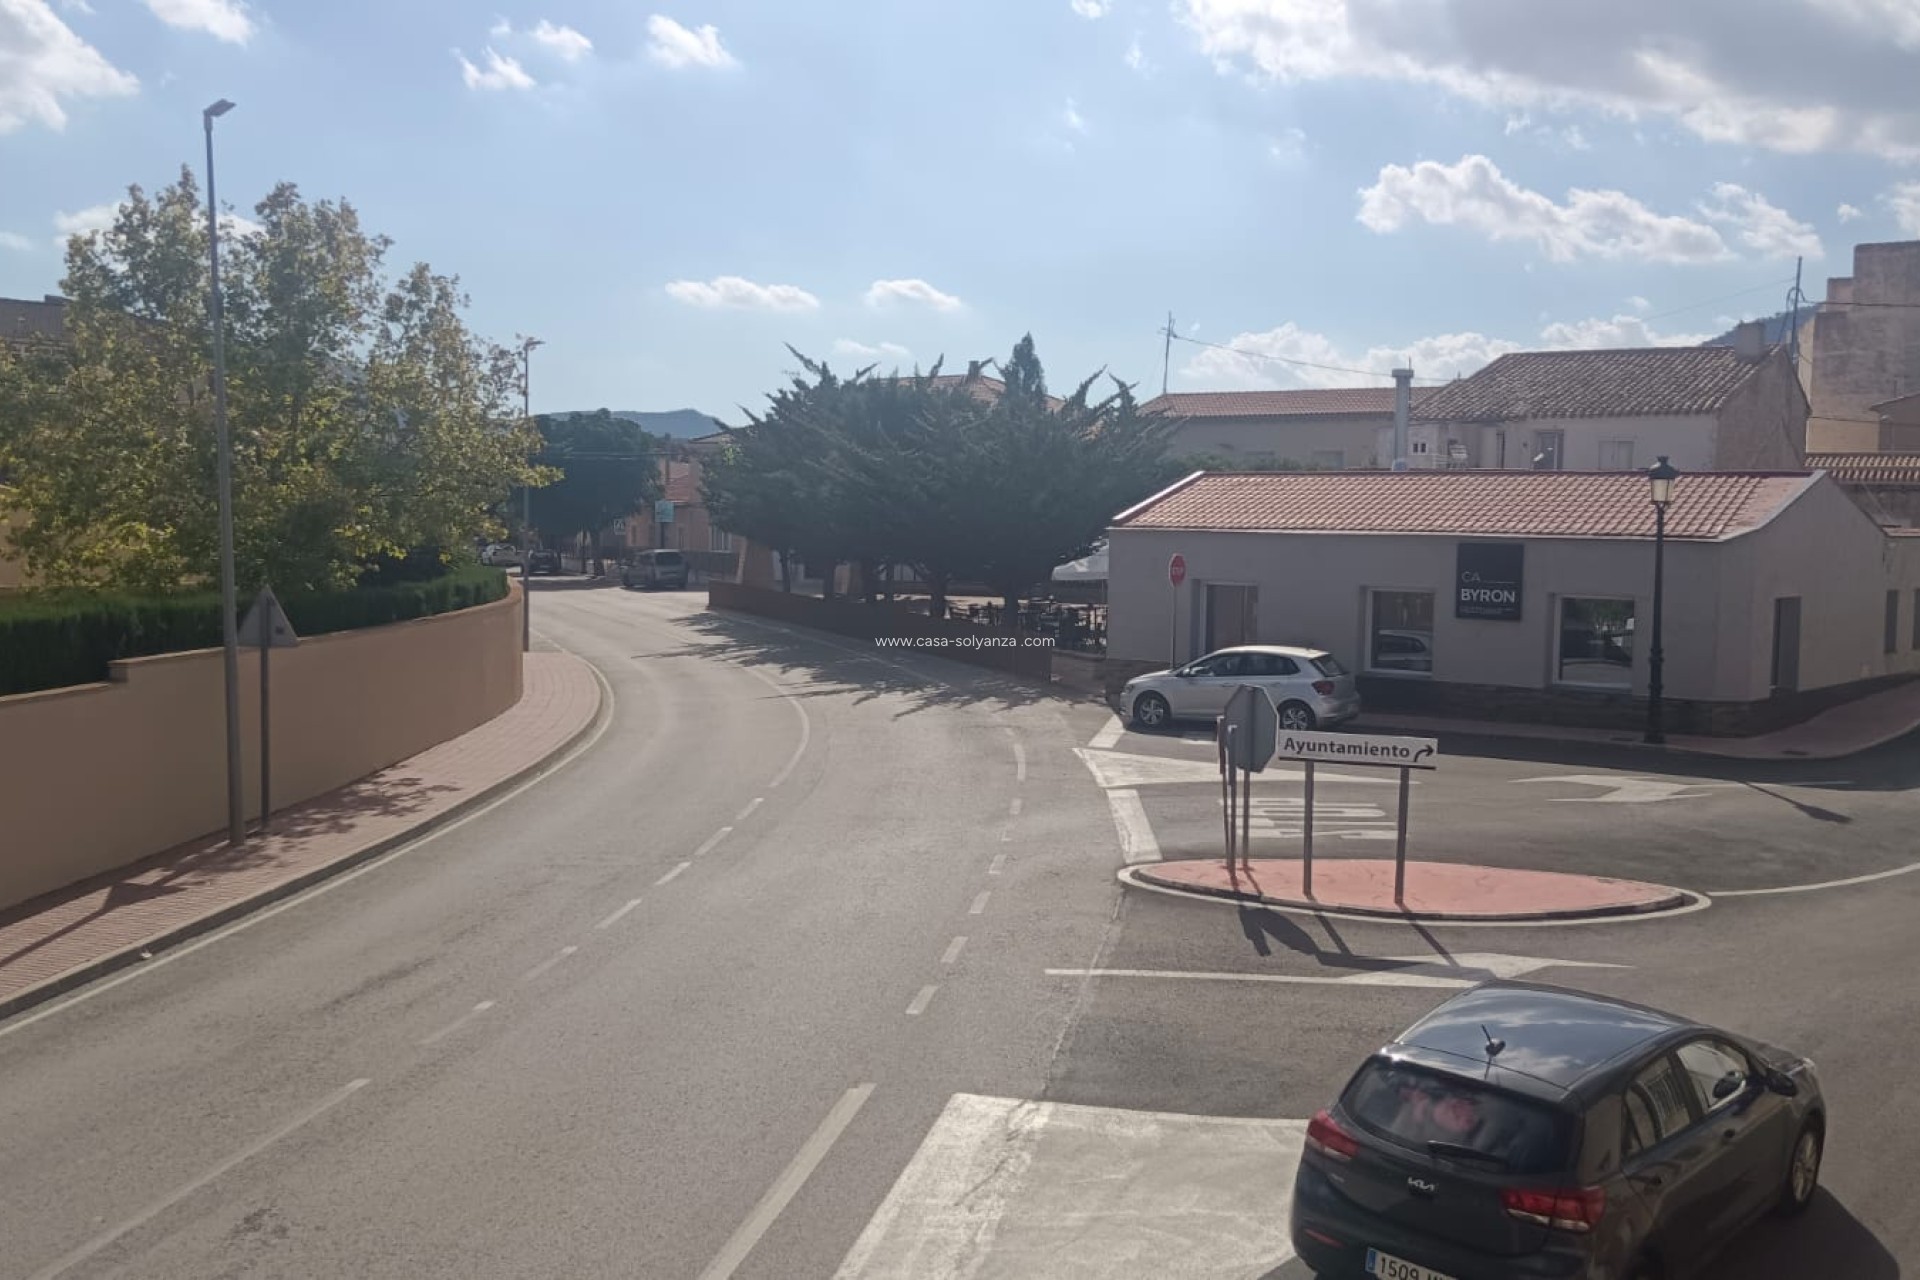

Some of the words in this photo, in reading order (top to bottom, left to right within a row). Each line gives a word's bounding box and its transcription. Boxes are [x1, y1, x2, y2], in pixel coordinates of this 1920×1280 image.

[1461, 571, 1481, 583] CA
[1461, 588, 1516, 604] BYRON
[1284, 737, 1410, 758] Ayuntamiento
[1380, 1256, 1420, 1280] 1509
